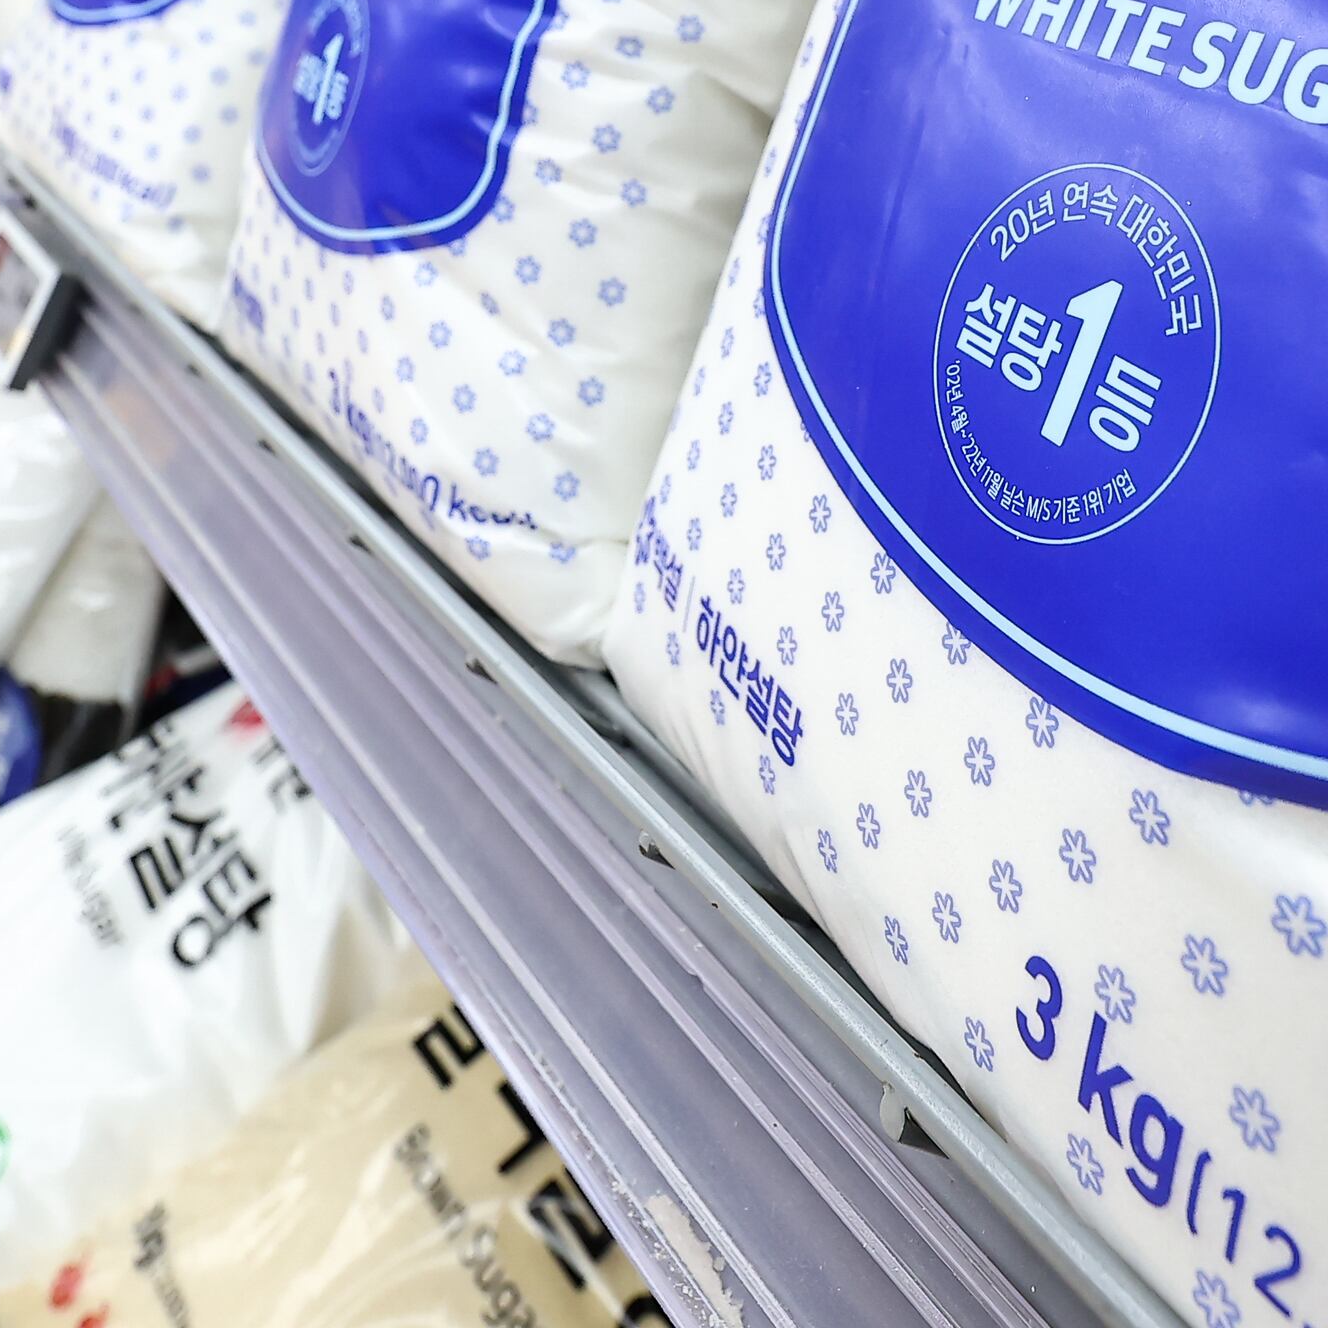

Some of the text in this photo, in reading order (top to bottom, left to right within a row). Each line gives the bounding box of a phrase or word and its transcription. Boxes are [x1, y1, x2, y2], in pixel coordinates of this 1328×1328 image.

[990, 181, 1202, 336] 20년 연속 대한민국
[980, 466, 1004, 501] 11월
[1000, 481, 1025, 516] 닐슨
[1025, 495, 1051, 523] M/S
[1053, 496, 1081, 525] 기준
[1082, 487, 1105, 517] 1위
[1103, 468, 1137, 505] 기업
[696, 595, 803, 767] 하얀설탕
[1016, 955, 1063, 1061] 3
